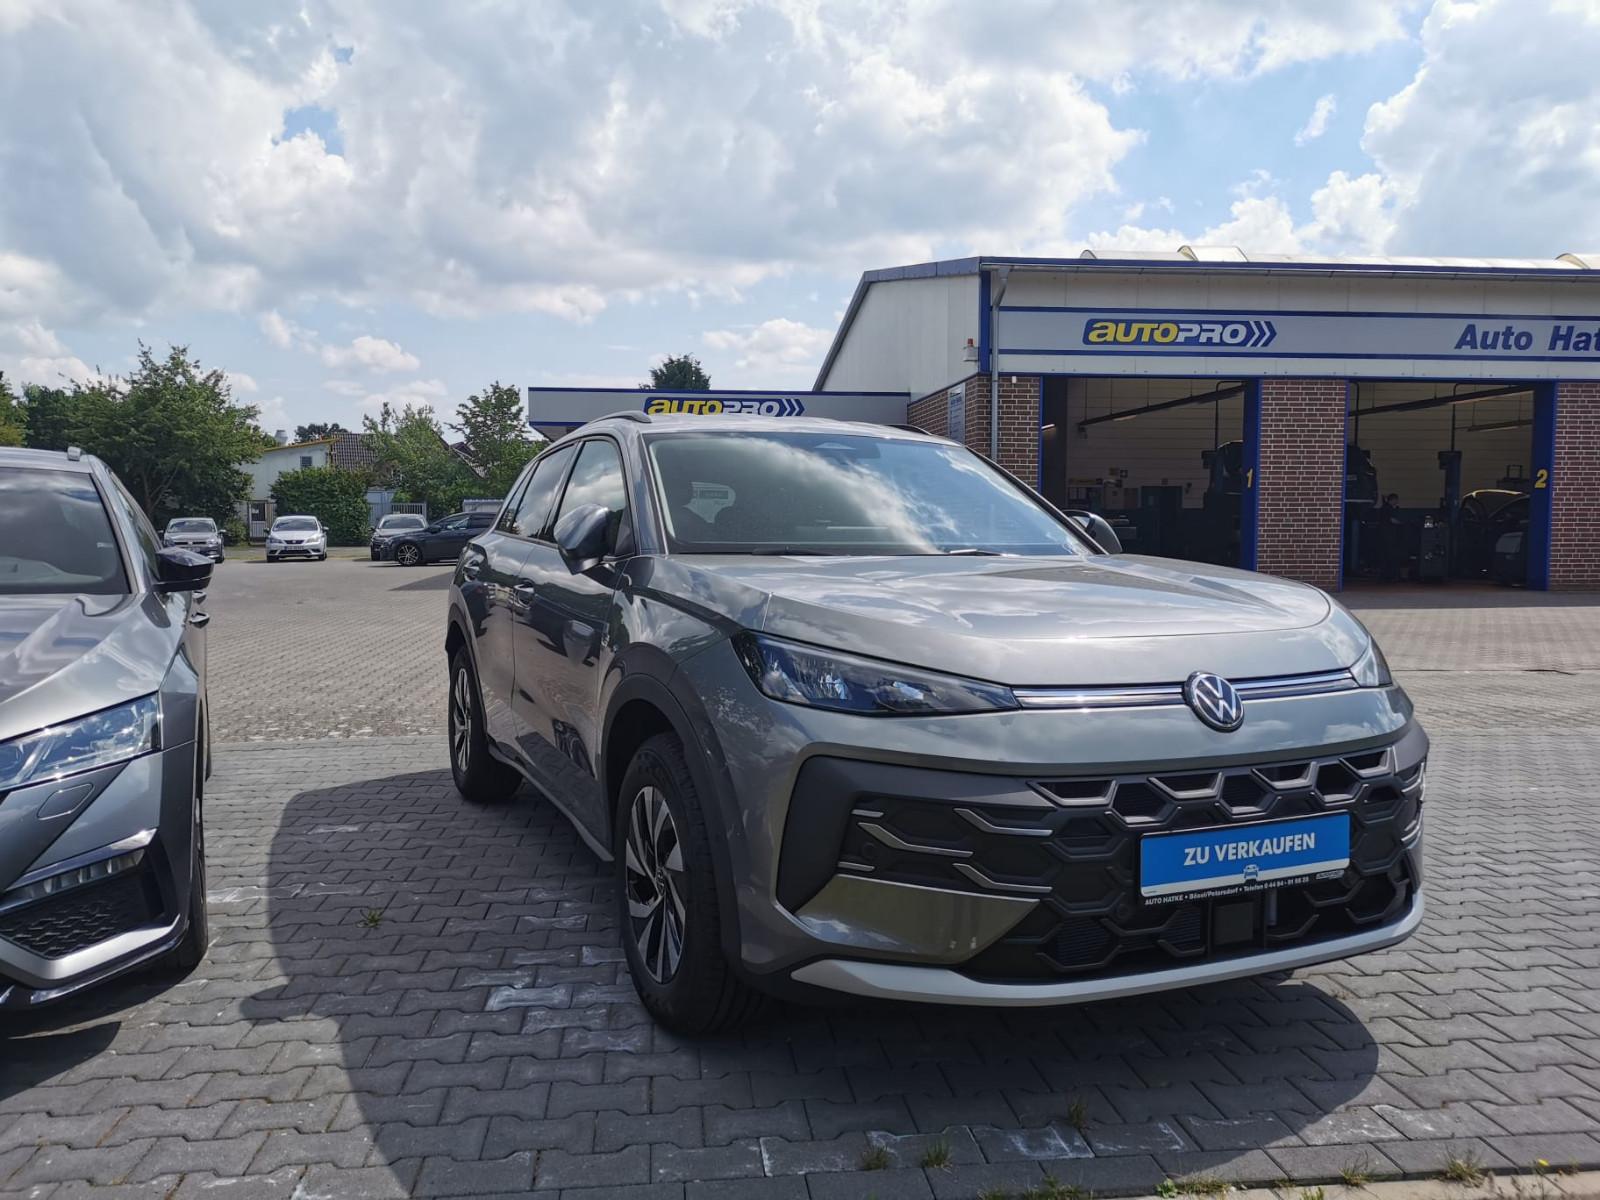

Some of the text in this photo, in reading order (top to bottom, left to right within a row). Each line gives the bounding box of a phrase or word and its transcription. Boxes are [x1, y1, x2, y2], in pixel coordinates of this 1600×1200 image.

[1454, 324, 1533, 351] Auto
[1246, 468, 1253, 488] 1
[1534, 469, 1548, 488] 2
[1183, 832, 1315, 866] ZU VERKAUFEN
[1145, 897, 1162, 905] AUTO
